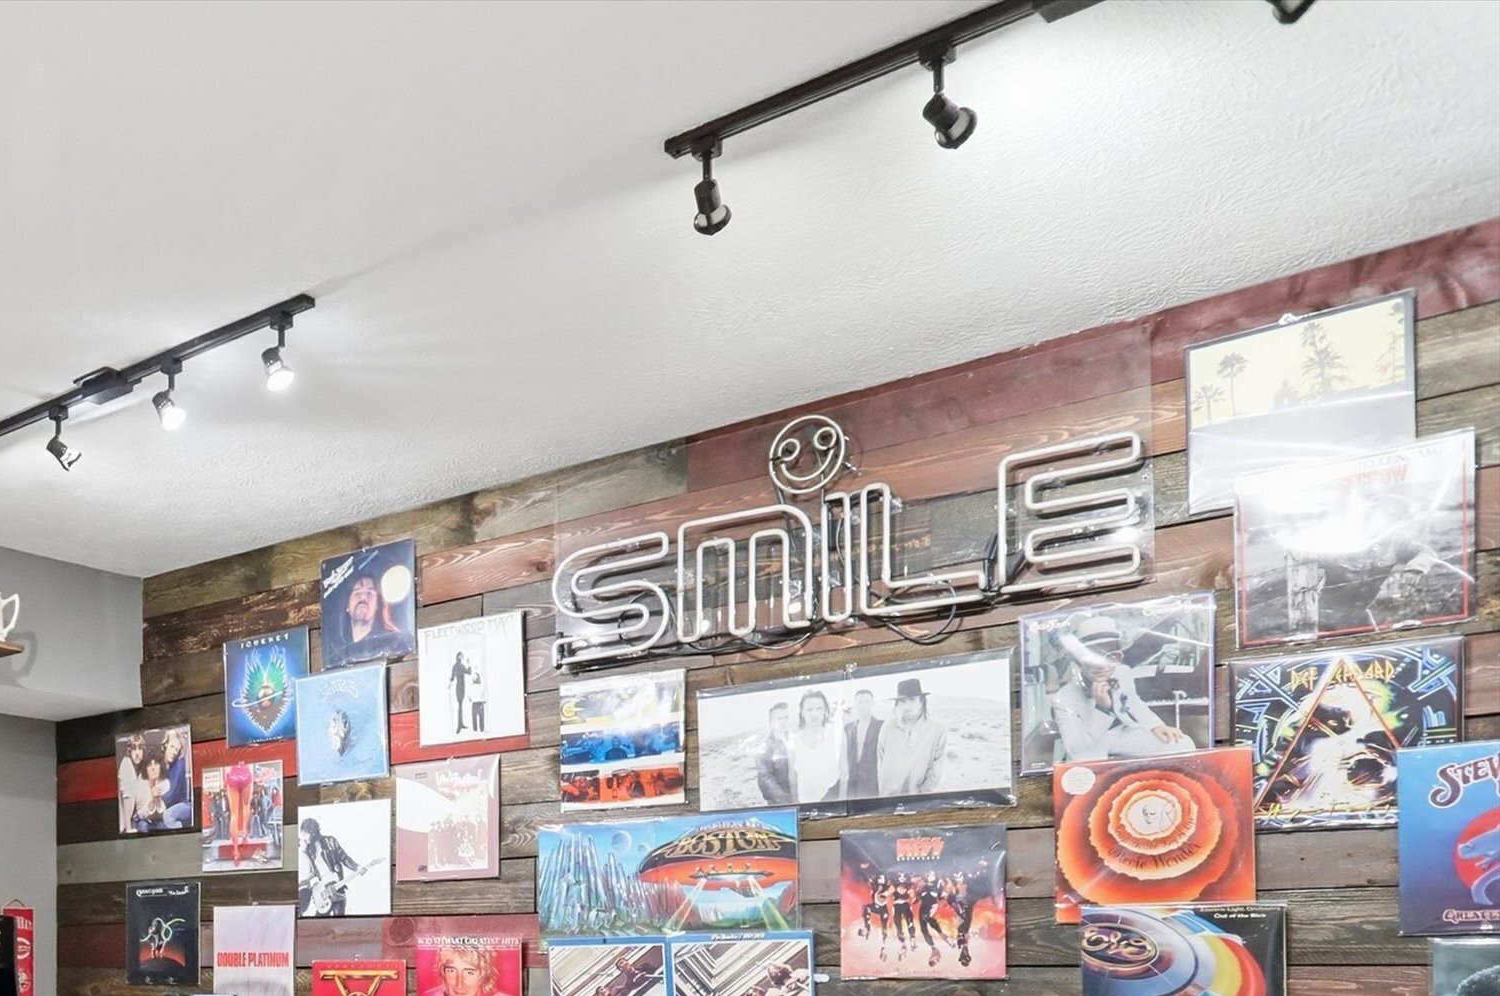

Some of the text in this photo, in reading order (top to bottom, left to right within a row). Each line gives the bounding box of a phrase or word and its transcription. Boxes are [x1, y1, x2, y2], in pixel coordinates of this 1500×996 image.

[665, 830, 781, 858] BOSTON
[217, 952, 290, 967] DOUBLE PLATINUM
